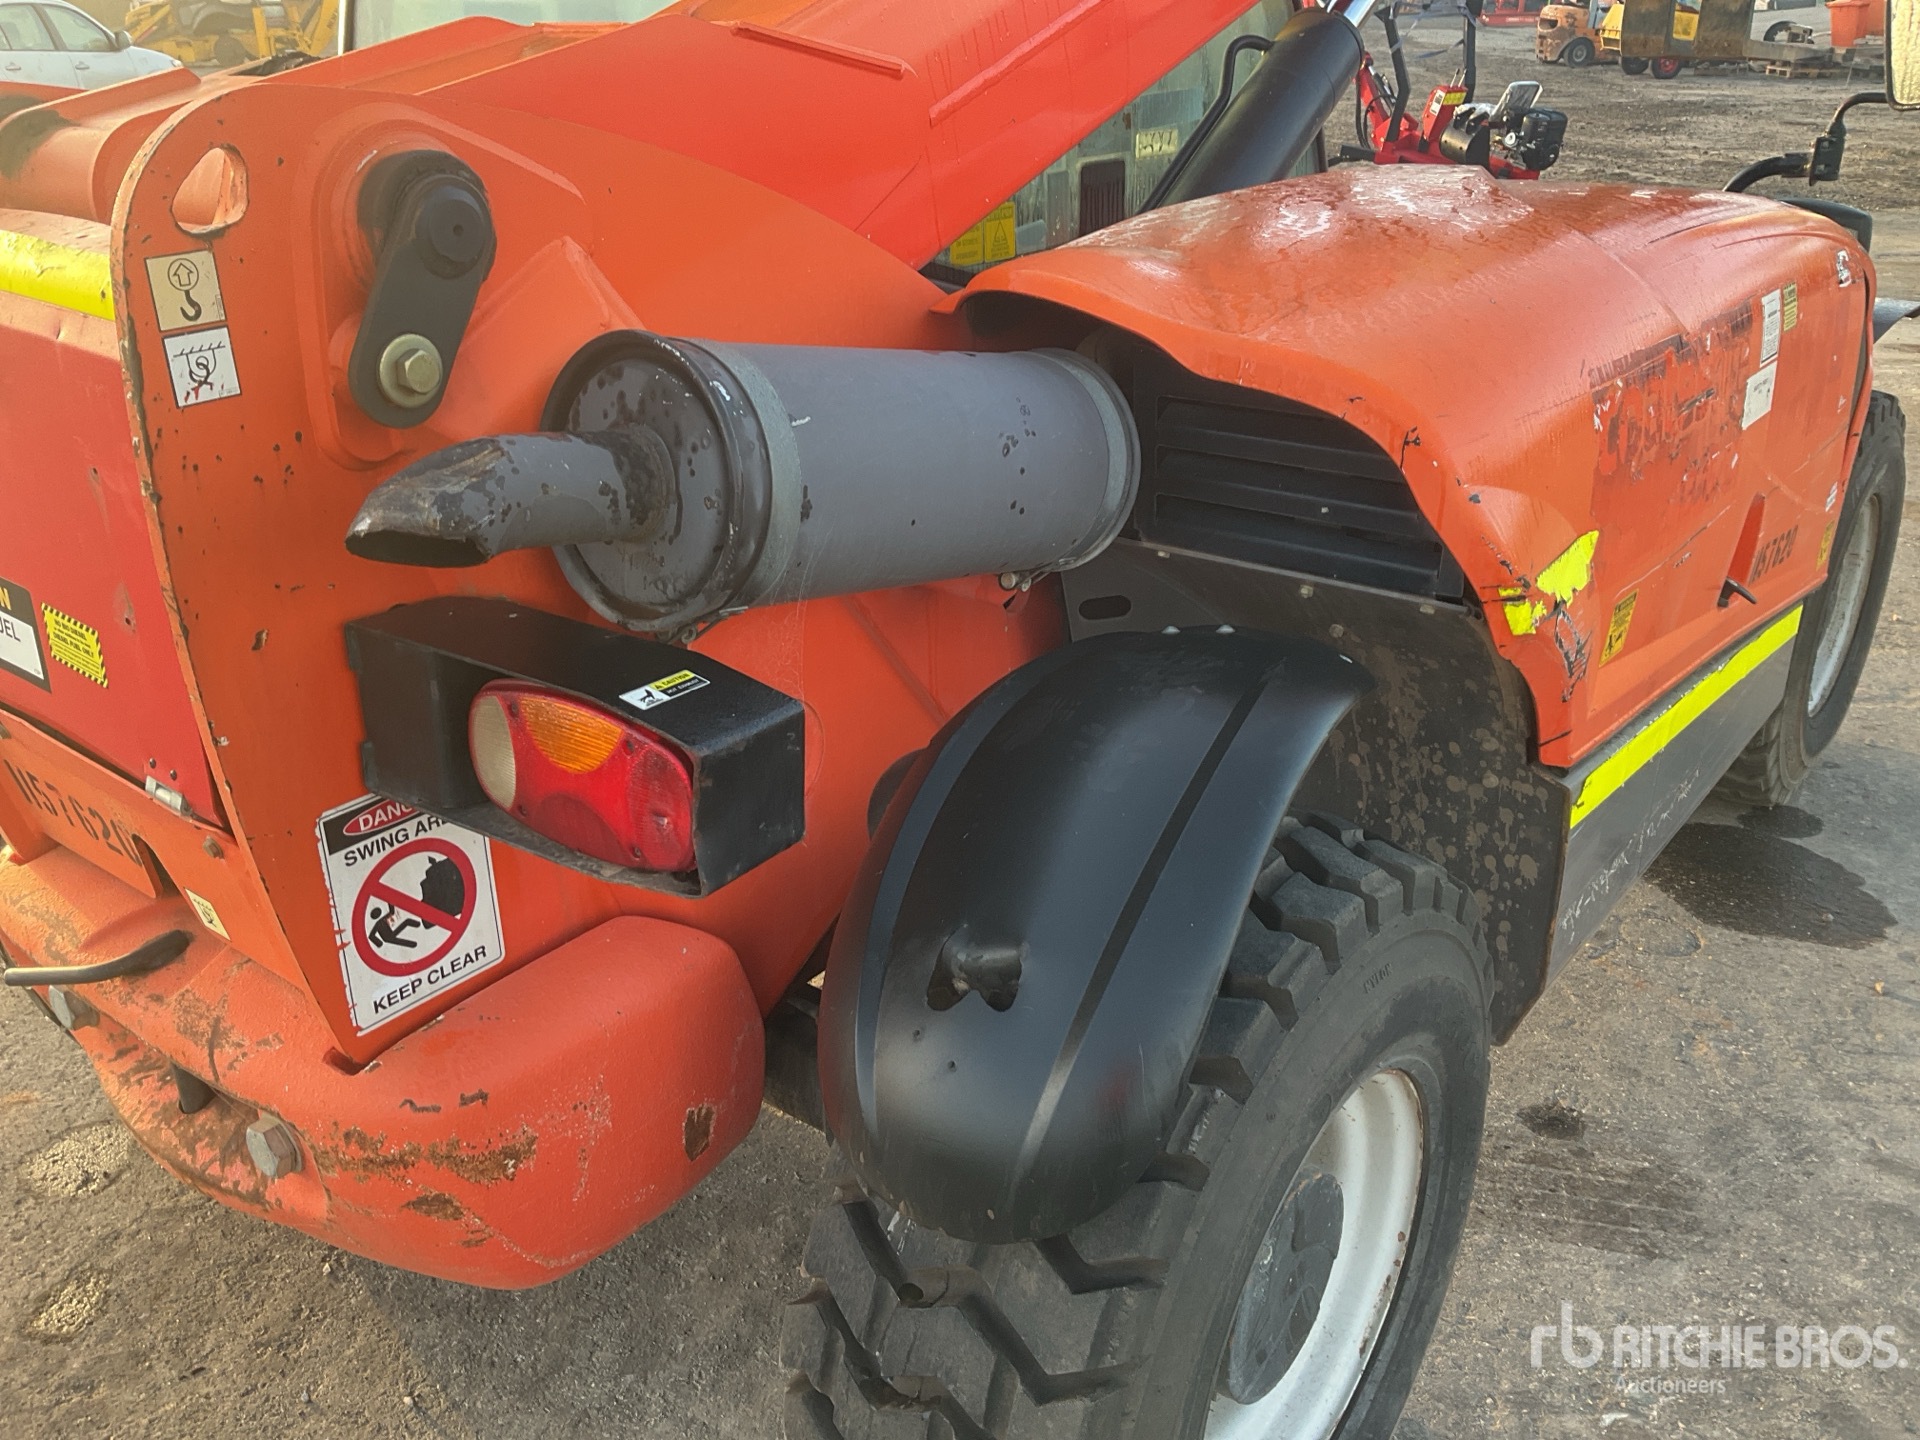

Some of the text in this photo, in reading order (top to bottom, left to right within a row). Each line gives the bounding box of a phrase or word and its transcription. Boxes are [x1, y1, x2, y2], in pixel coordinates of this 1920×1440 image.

[344, 828, 410, 867] SWING
[373, 945, 487, 1014] KEEP CLEAR
